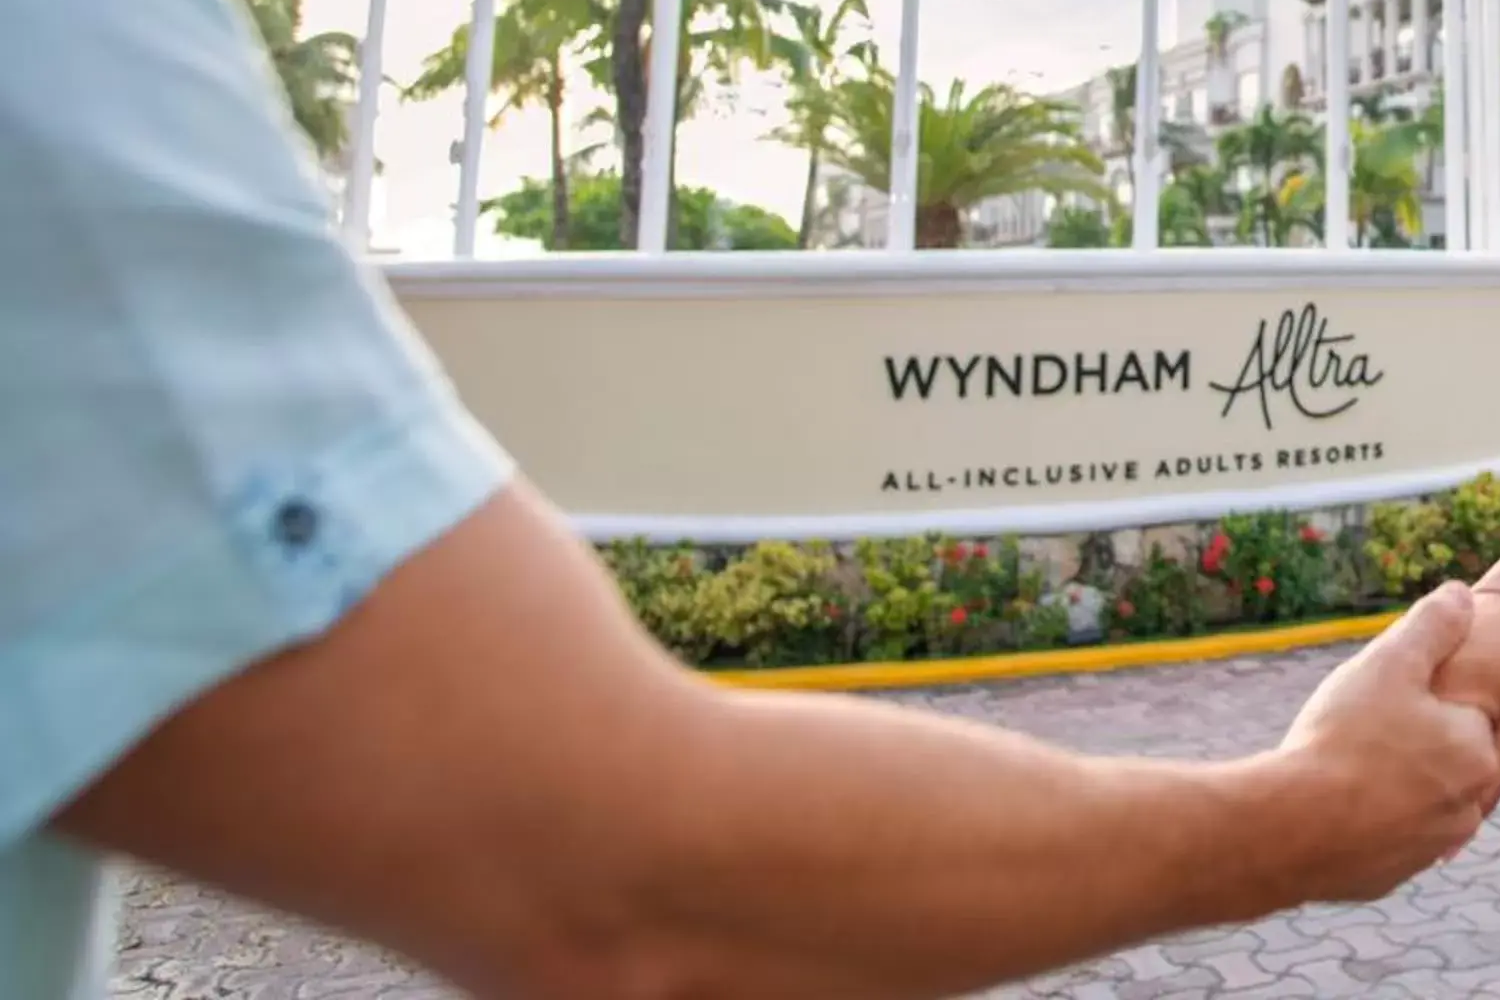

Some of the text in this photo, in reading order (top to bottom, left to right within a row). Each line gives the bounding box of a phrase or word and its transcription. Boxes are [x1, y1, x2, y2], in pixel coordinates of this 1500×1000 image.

[884, 302, 1384, 431] WYNDHAM Alltra
[880, 441, 1385, 492] ALL-INCLUSIVE ADULTS RESORTS
